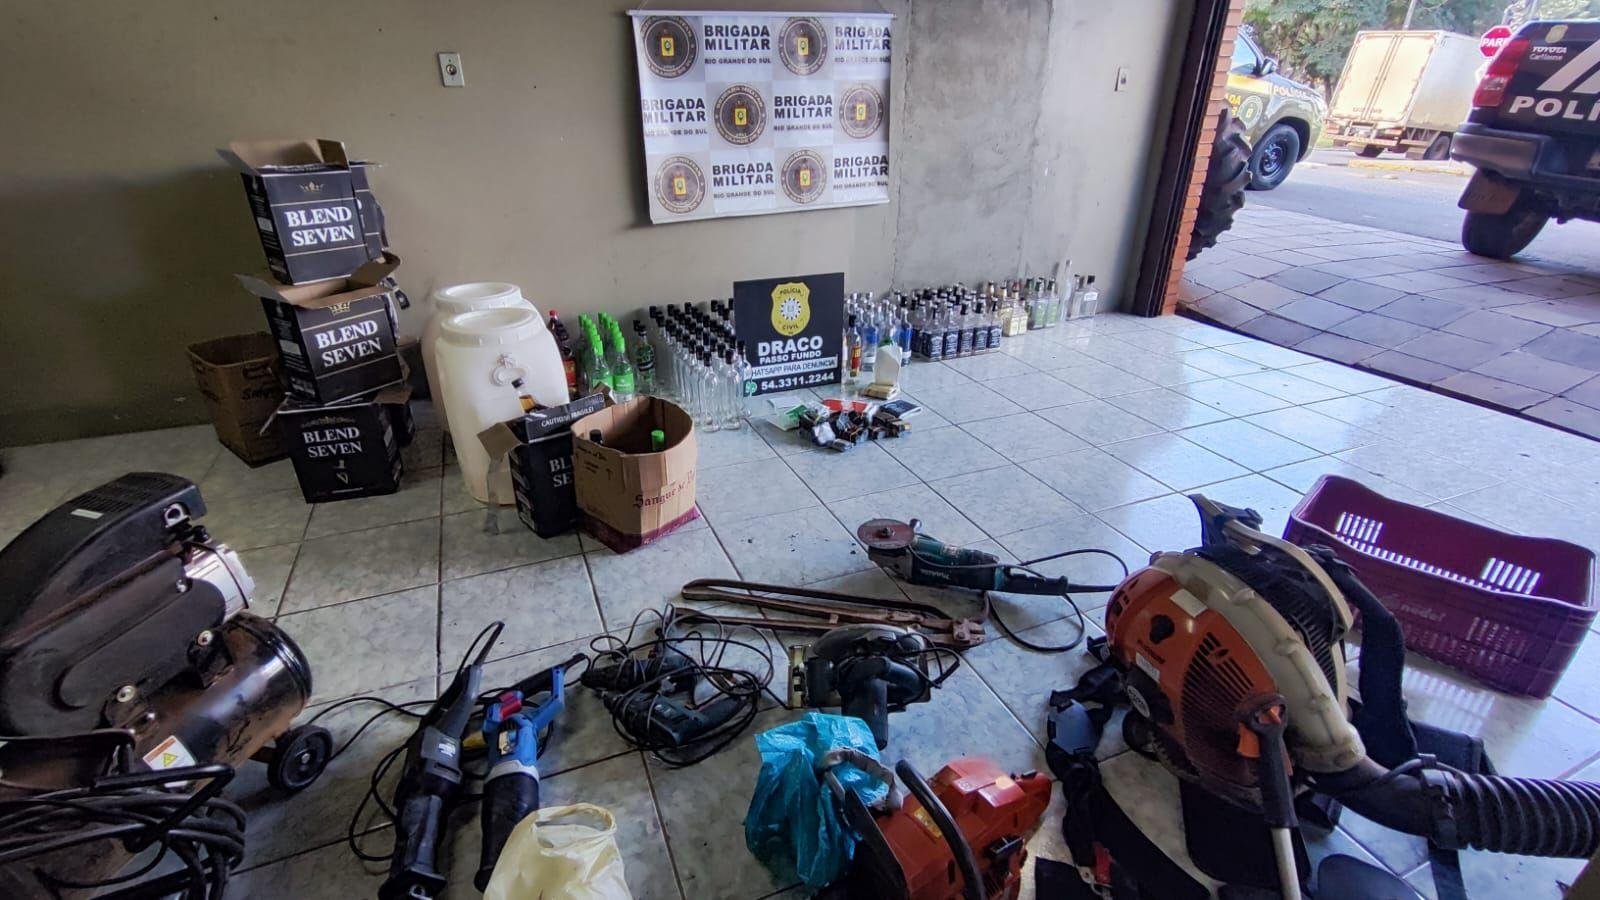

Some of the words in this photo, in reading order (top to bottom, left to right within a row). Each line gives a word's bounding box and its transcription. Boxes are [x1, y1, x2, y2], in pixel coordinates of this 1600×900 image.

[704, 25, 770, 37] BRIGADA
[835, 26, 891, 38] BRIGADA
[704, 38, 770, 51] MILITAR
[834, 39, 891, 50] MILITAR
[642, 98, 706, 110] BRIGADA
[774, 95, 833, 107] BRIGADA
[774, 106, 833, 119] MILITAR
[1509, 95, 1600, 122] POLÍ
[643, 110, 706, 123] MILITAR
[834, 155, 889, 168] BRIGADA
[712, 162, 774, 176] BRIGADA
[834, 166, 888, 179] MILITAR
[713, 173, 774, 187] MILITAR
[285, 206, 352, 228] BLEND
[291, 225, 356, 247] SEVEN
[315, 320, 378, 349] BLEND
[322, 337, 383, 368] SEVEN
[757, 335, 824, 357] DRACO
[759, 354, 789, 365] PASSO
[790, 350, 822, 360] FUNDO
[750, 366, 783, 377] HATSAPP
[783, 363, 802, 373] PARA
[761, 372, 835, 391] 54.3311.2244
[302, 426, 361, 444] BLEND
[307, 441, 363, 458] SEVEN
